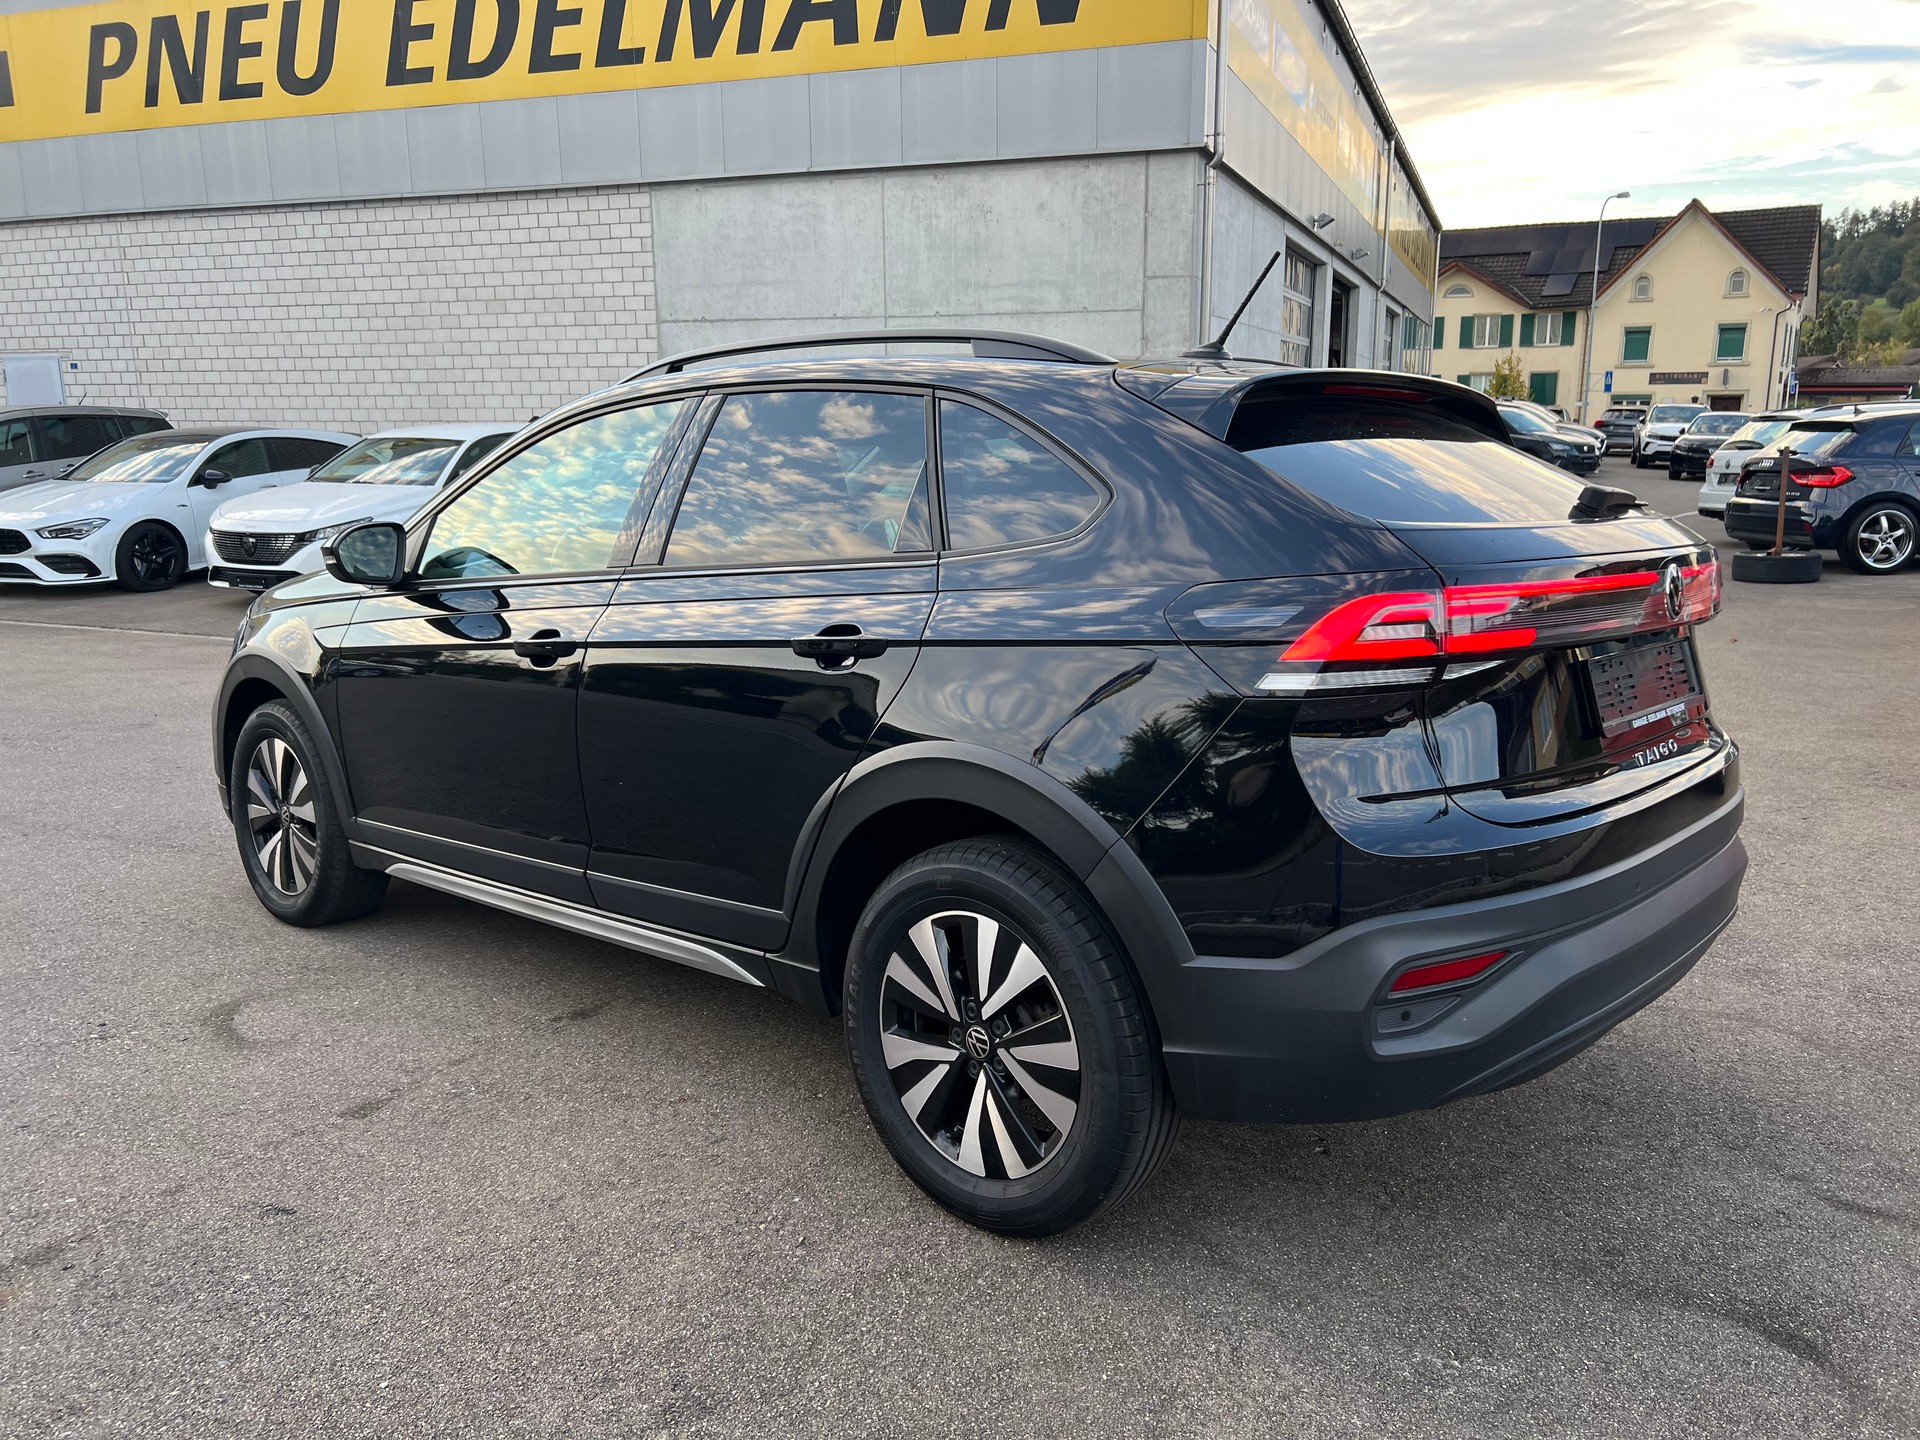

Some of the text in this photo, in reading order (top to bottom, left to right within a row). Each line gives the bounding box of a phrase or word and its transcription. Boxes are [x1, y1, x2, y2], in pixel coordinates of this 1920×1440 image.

[85, 0, 342, 114] PNEU
[385, 0, 1082, 87] EDELMA
[1632, 715, 1648, 728] GARAGE
[1648, 710, 1667, 722] EDELMANN
[1634, 738, 1678, 766] TAIGO
